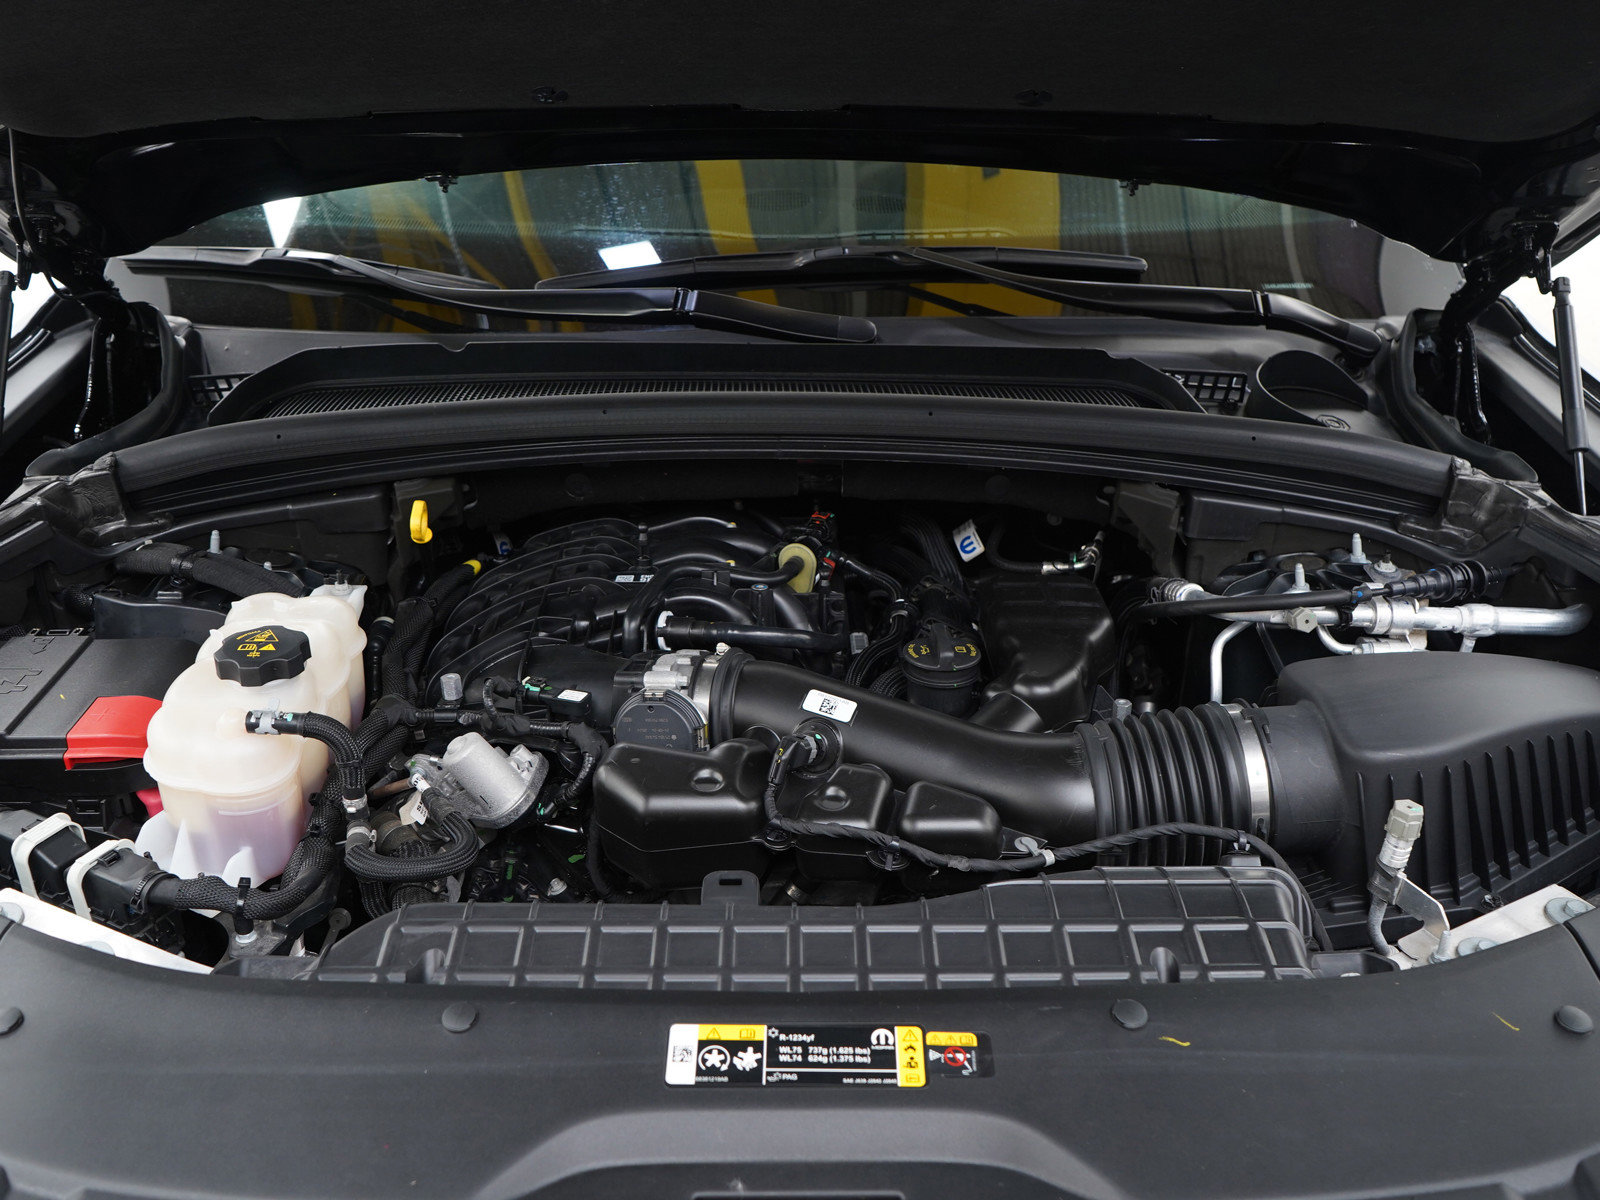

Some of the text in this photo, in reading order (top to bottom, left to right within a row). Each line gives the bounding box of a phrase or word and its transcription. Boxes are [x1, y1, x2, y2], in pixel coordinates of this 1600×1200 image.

[779, 1033, 815, 1043] R-1234yf
[779, 1046, 871, 1056] WL75 737g (1.625 lbs)
[779, 1054, 872, 1064] WL74 624g (1.375 lbs)
